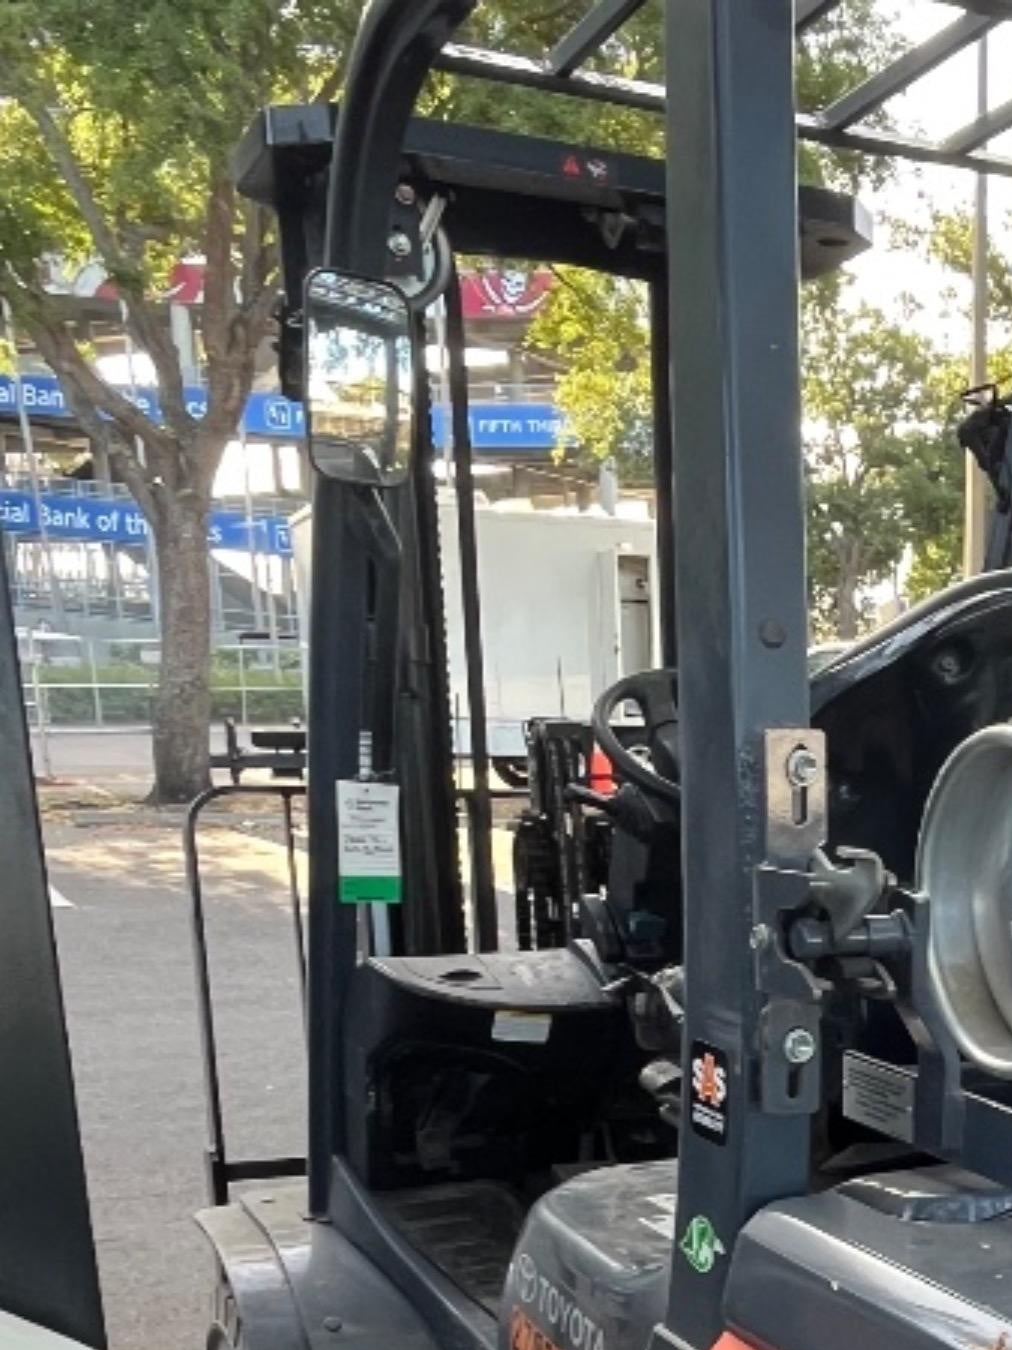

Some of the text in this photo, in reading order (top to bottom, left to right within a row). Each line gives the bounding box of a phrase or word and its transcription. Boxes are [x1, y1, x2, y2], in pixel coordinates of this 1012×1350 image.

[22, 383, 64, 409] Ban
[41, 504, 90, 529] Bank
[96, 510, 119, 532] of
[125, 514, 148, 535] th
